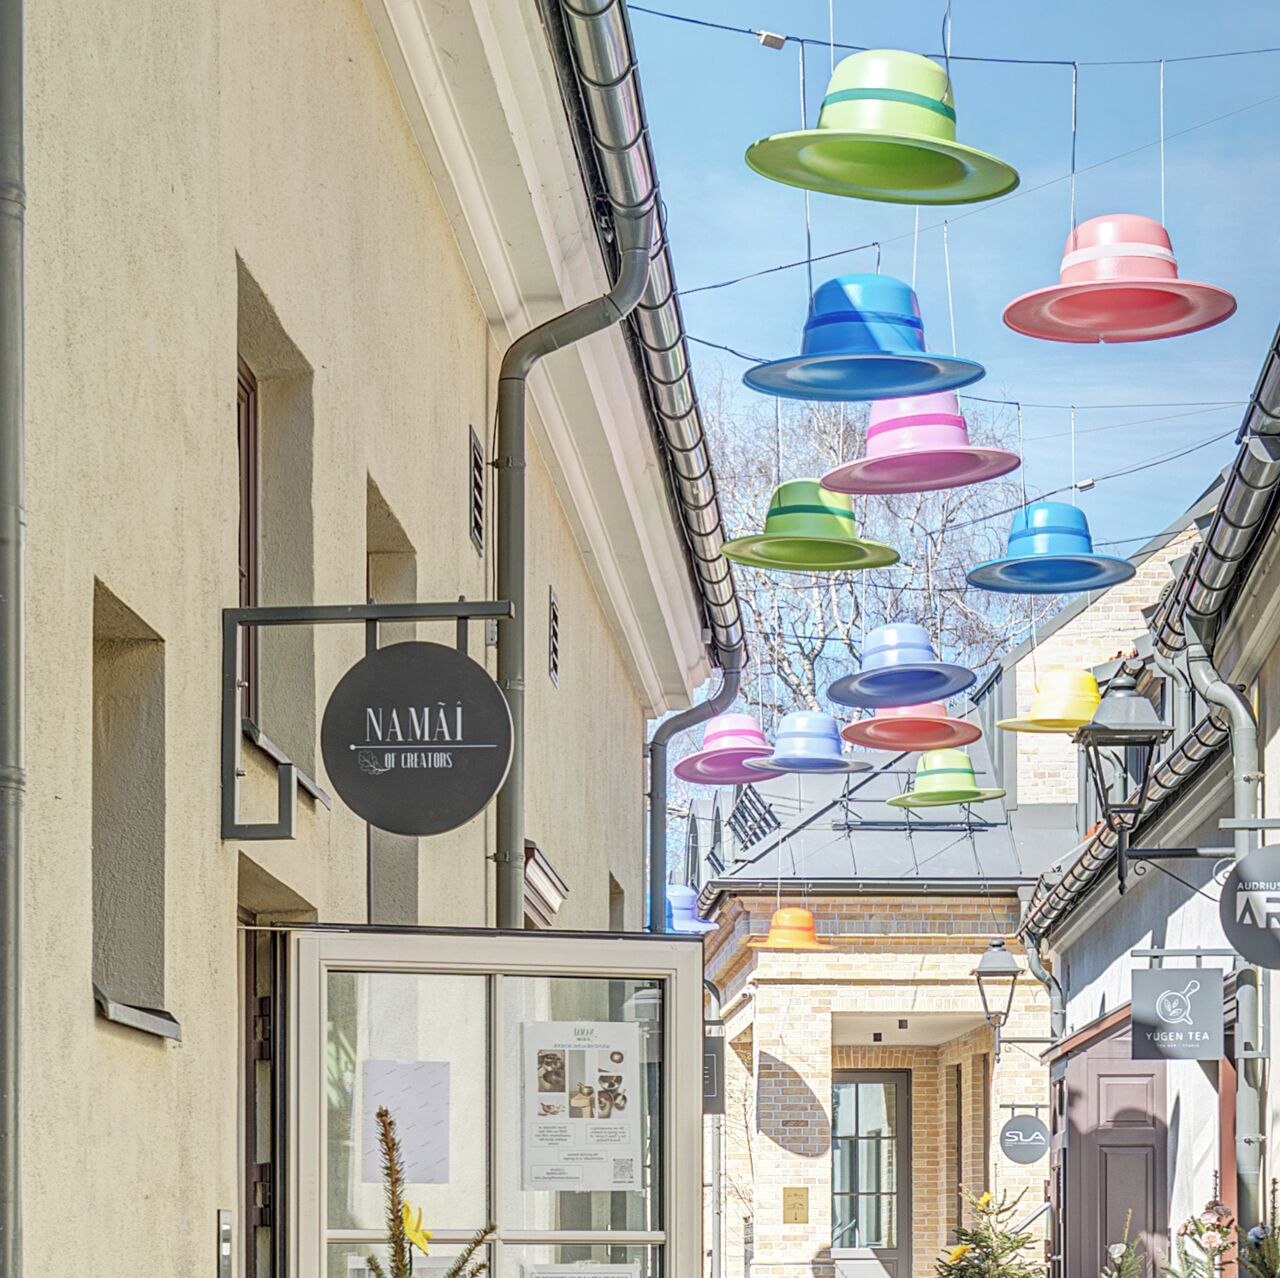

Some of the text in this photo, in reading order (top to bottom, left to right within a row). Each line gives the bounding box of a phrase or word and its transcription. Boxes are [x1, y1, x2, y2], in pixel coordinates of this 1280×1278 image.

[384, 751, 453, 769] OF CREATORS
[1145, 1031, 1210, 1041] YUGEN TEA
[1004, 1130, 1046, 1142] SLA
